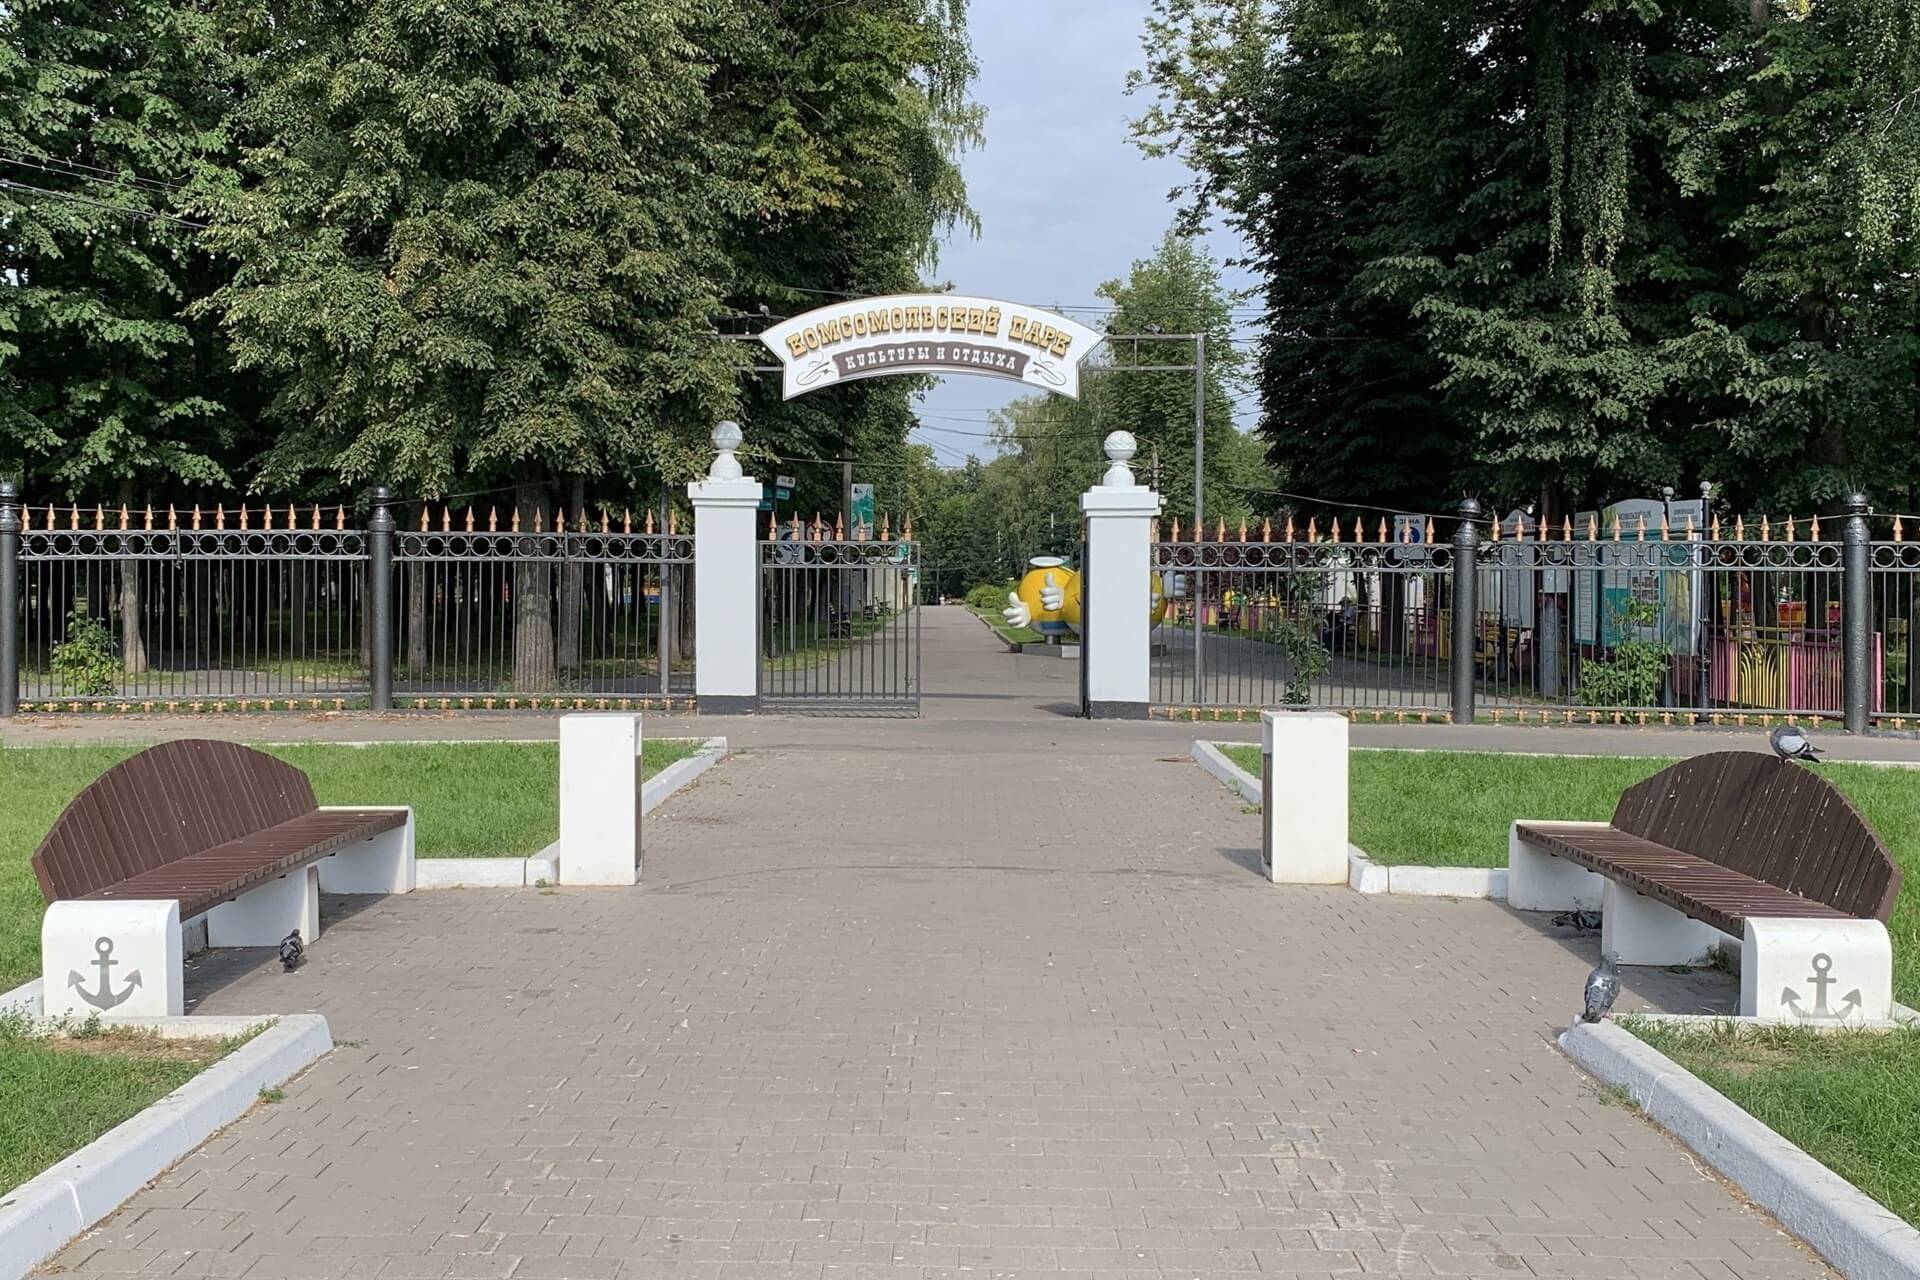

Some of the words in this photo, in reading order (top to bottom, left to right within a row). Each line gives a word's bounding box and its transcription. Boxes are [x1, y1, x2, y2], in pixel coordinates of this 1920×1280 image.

[786, 306, 1001, 358] КОМСОМОЛЬСКИЙ
[1008, 315, 1072, 357] ПАРК
[845, 347, 929, 369] КУЛЬТУРЫ
[936, 347, 945, 360] И
[952, 348, 1016, 370] ОТДЫХА
